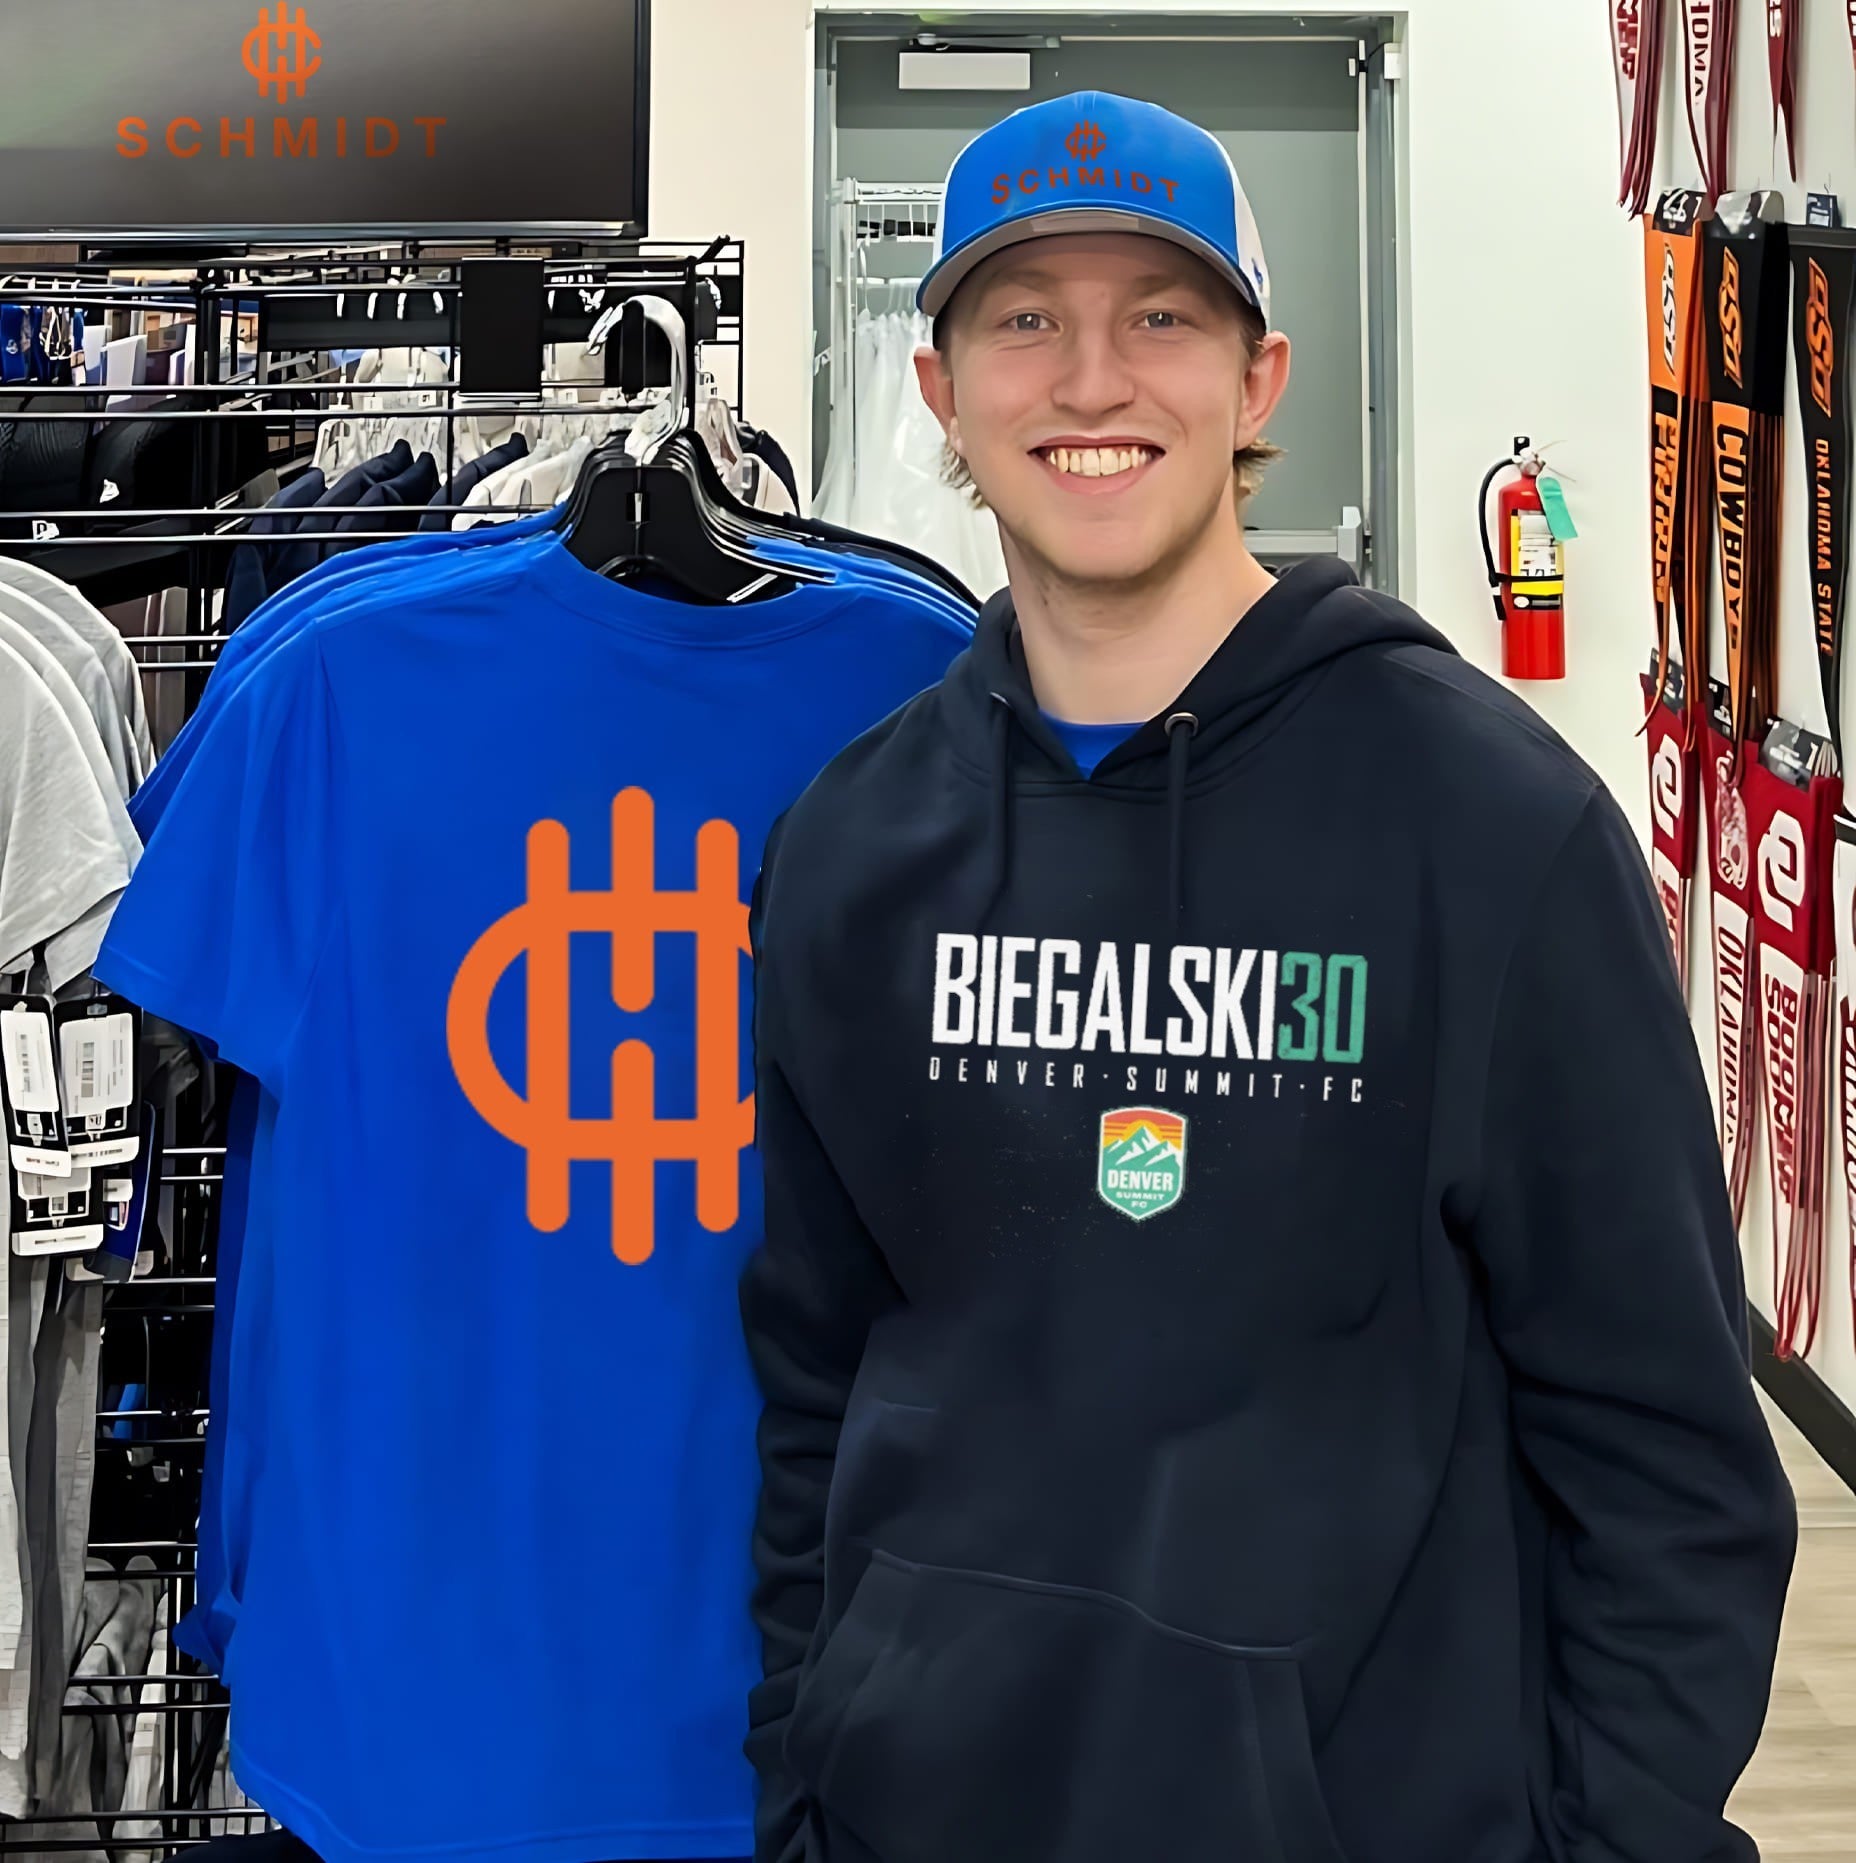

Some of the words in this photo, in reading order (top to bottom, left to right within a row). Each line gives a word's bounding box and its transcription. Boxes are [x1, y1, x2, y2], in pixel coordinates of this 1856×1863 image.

[115, 115, 448, 159] SCHMIDT
[990, 166, 1180, 205] SCHMIDT
[1815, 438, 1832, 571] OKLAHOMA
[1107, 1169, 1174, 1191] DENVER
[1116, 1191, 1165, 1201] SUMMIT
[1131, 1200, 1148, 1208] FC
